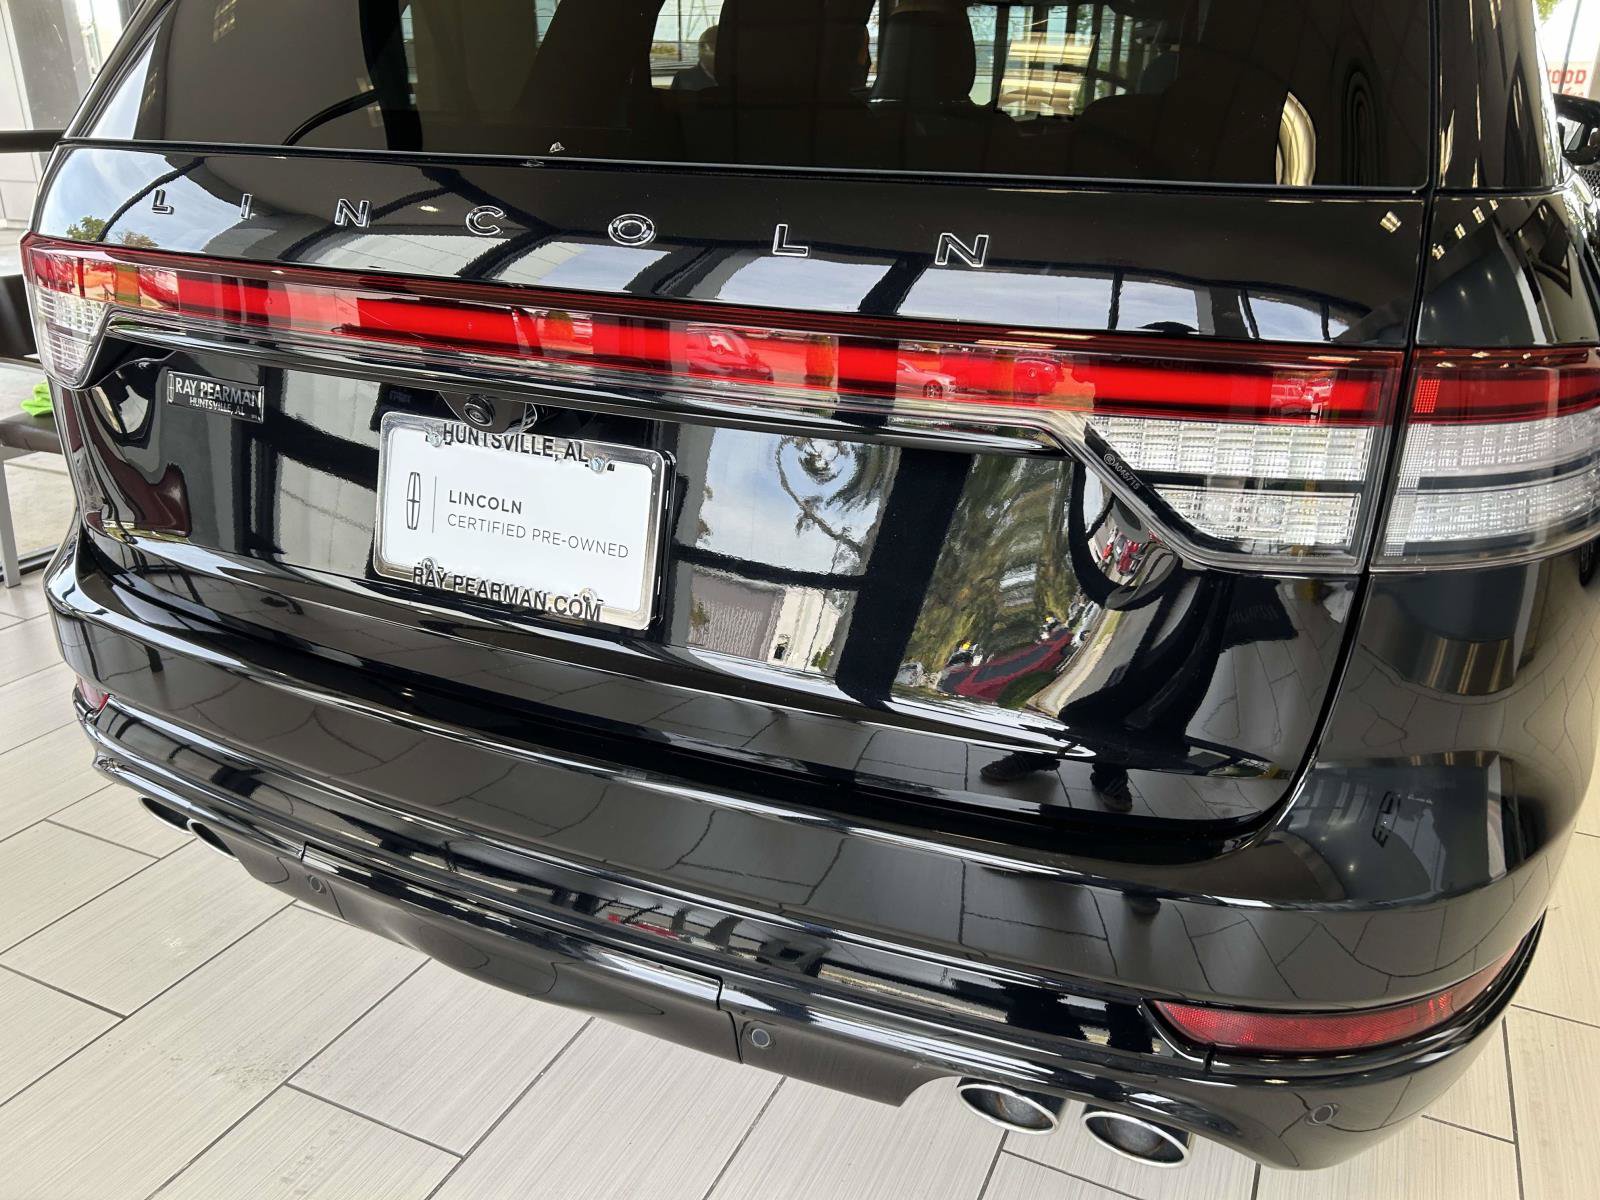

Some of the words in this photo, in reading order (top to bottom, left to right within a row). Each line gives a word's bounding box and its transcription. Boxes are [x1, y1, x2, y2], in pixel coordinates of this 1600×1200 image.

[152, 188, 990, 270] LINCOLN
[175, 377, 197, 395] RAY
[200, 381, 261, 408] PEARMAN
[189, 396, 233, 415] HUNTSVILLE,
[235, 406, 245, 415] AL
[443, 422, 559, 461] HUNTSVILLE,
[564, 441, 589, 463] AL
[449, 490, 522, 515] LINCOLN
[447, 513, 526, 540] CERTIFIED
[532, 528, 628, 559] PRE-OWNED
[413, 566, 447, 589] RAY
[453, 574, 601, 622] PEARMAN.COM
